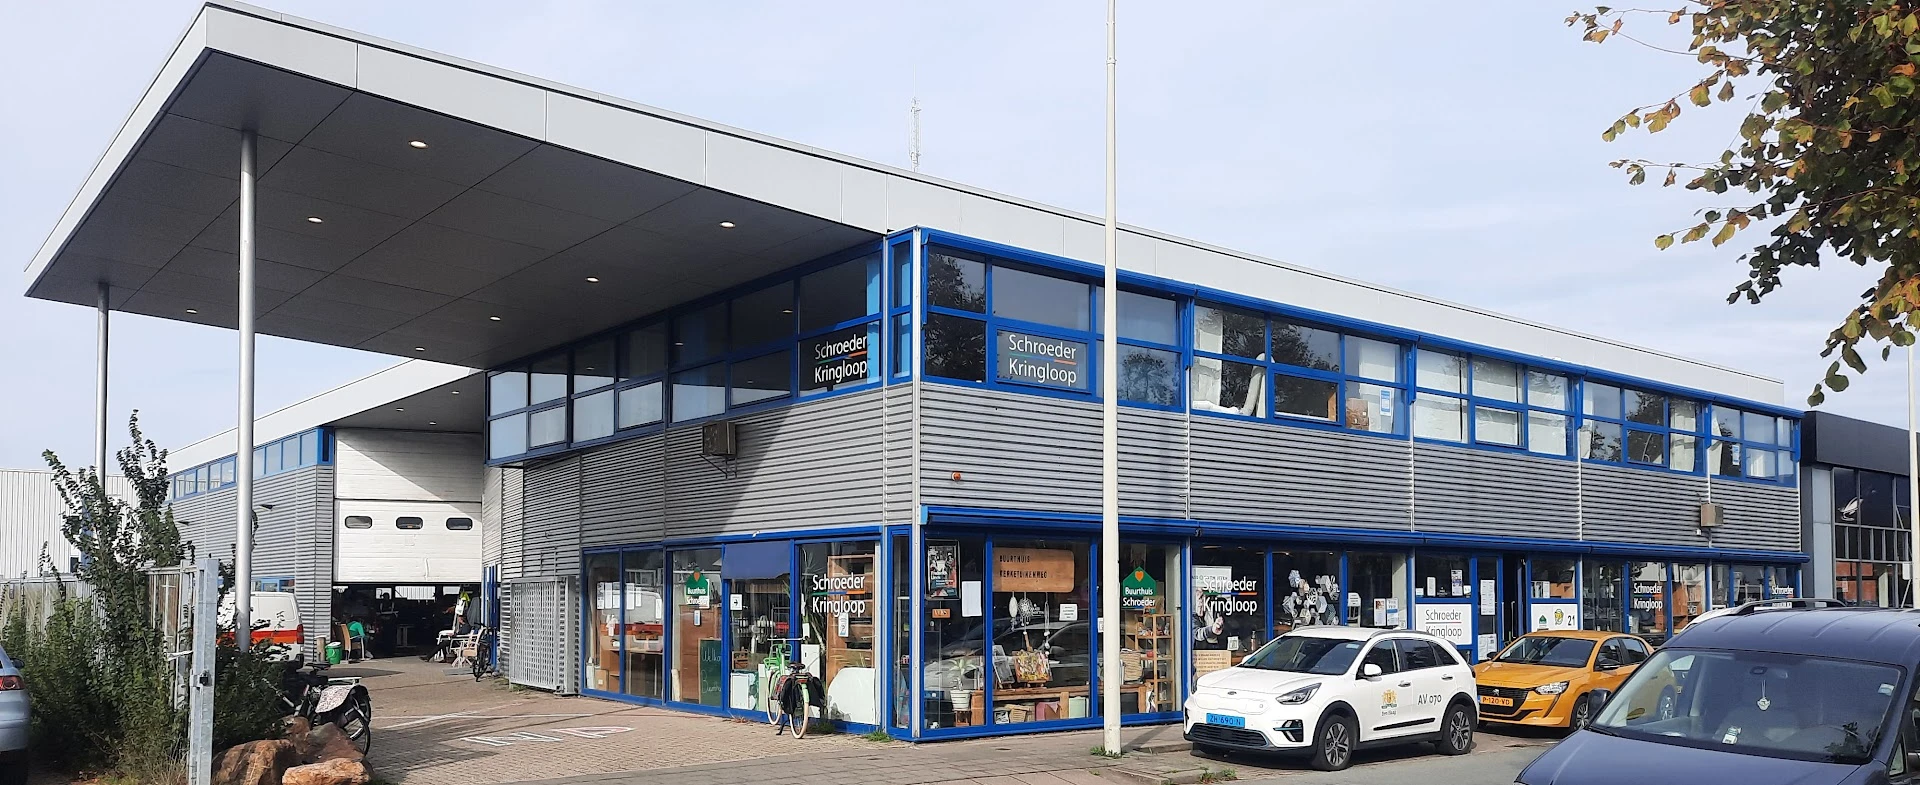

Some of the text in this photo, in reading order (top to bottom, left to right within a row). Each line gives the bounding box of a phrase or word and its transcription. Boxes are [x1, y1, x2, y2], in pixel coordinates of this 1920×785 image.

[815, 334, 867, 360] Schroeder
[1008, 334, 1077, 359] Schroeder
[814, 359, 867, 383] Kringloop
[1009, 357, 1077, 387] Kringloop
[812, 572, 865, 591] Schroeder
[1203, 576, 1257, 591] Schroeder
[1633, 582, 1663, 594] Schroeder
[1124, 586, 1154, 595] Buurthuis
[812, 595, 866, 618] Kringloop
[1122, 596, 1156, 607] Schroeder
[1203, 596, 1257, 616] Kringloop
[1633, 597, 1663, 612] Kringloop
[1425, 609, 1462, 621] Schroeder
[1567, 615, 1576, 626] 21
[1417, 693, 1443, 706] AV 070
